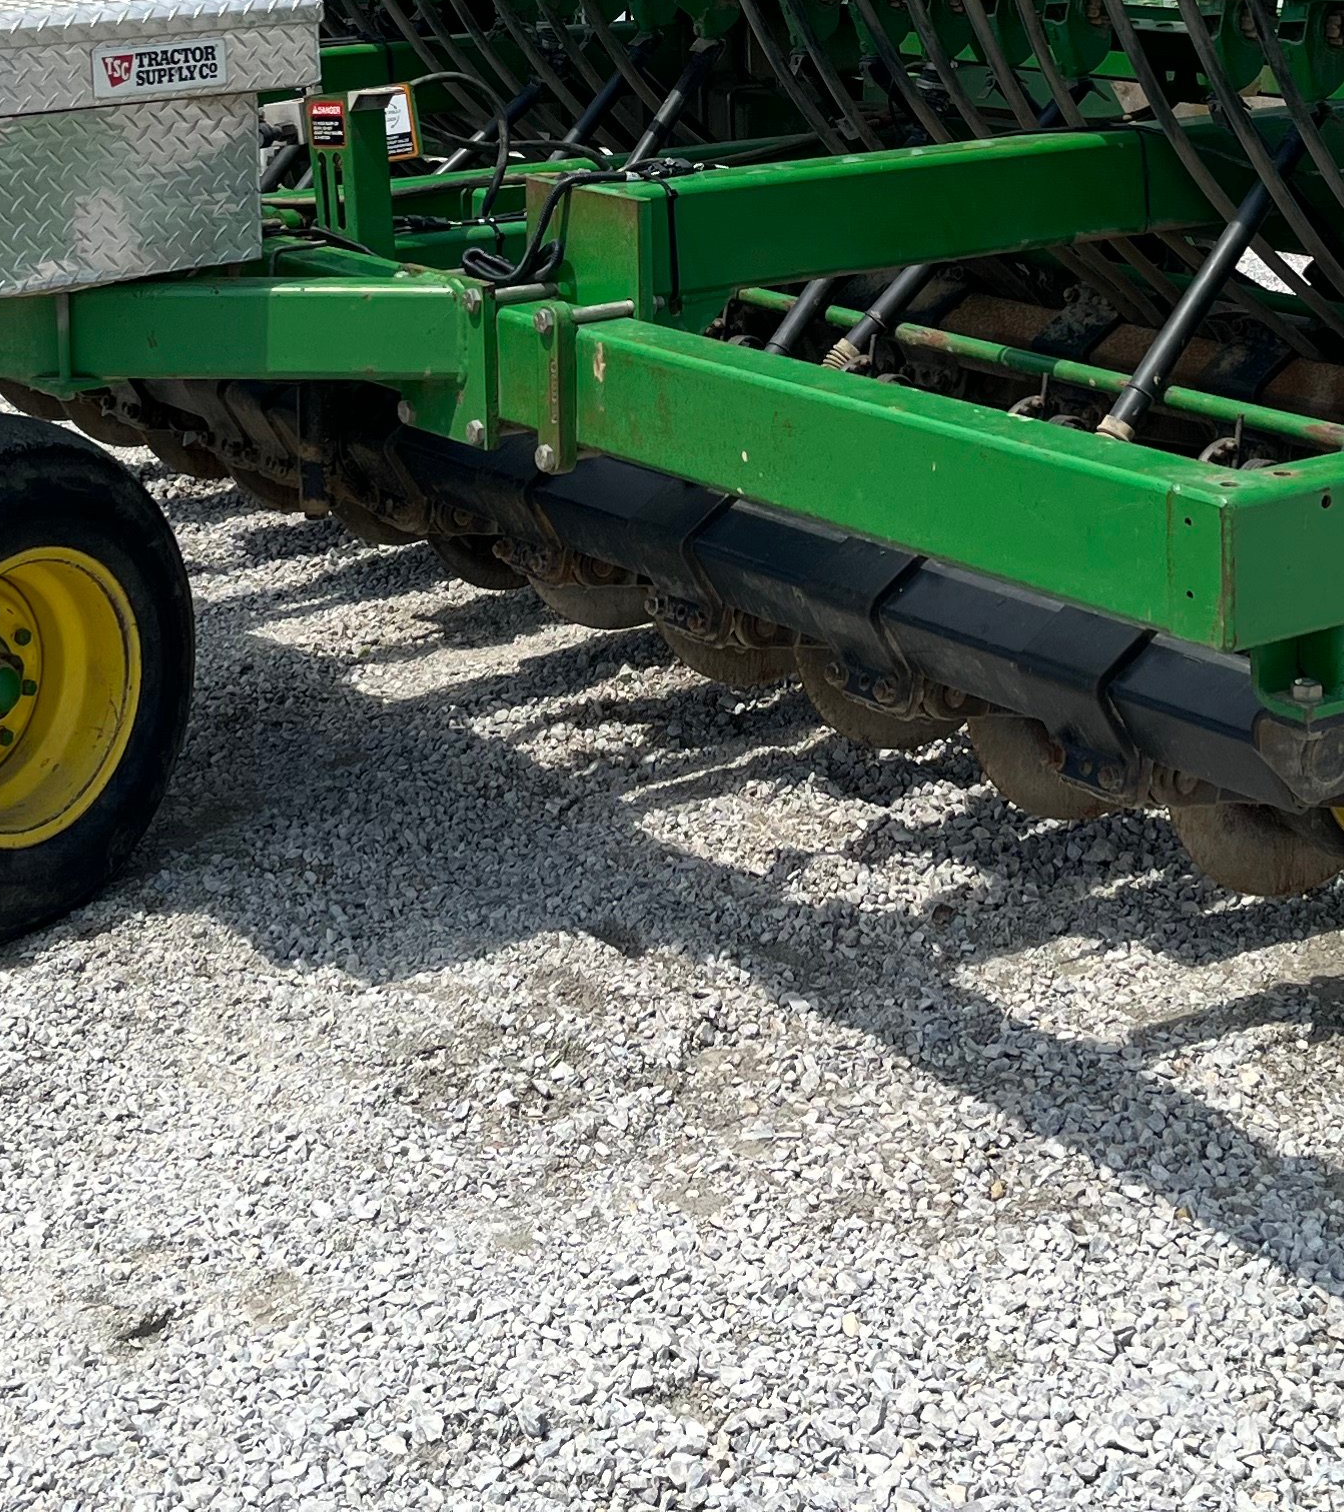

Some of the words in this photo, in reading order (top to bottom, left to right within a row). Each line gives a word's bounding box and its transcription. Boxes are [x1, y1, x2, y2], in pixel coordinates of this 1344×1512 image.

[135, 45, 216, 68] TRACTOR
[105, 57, 130, 81] TSC
[136, 65, 196, 86] SUPPLY
